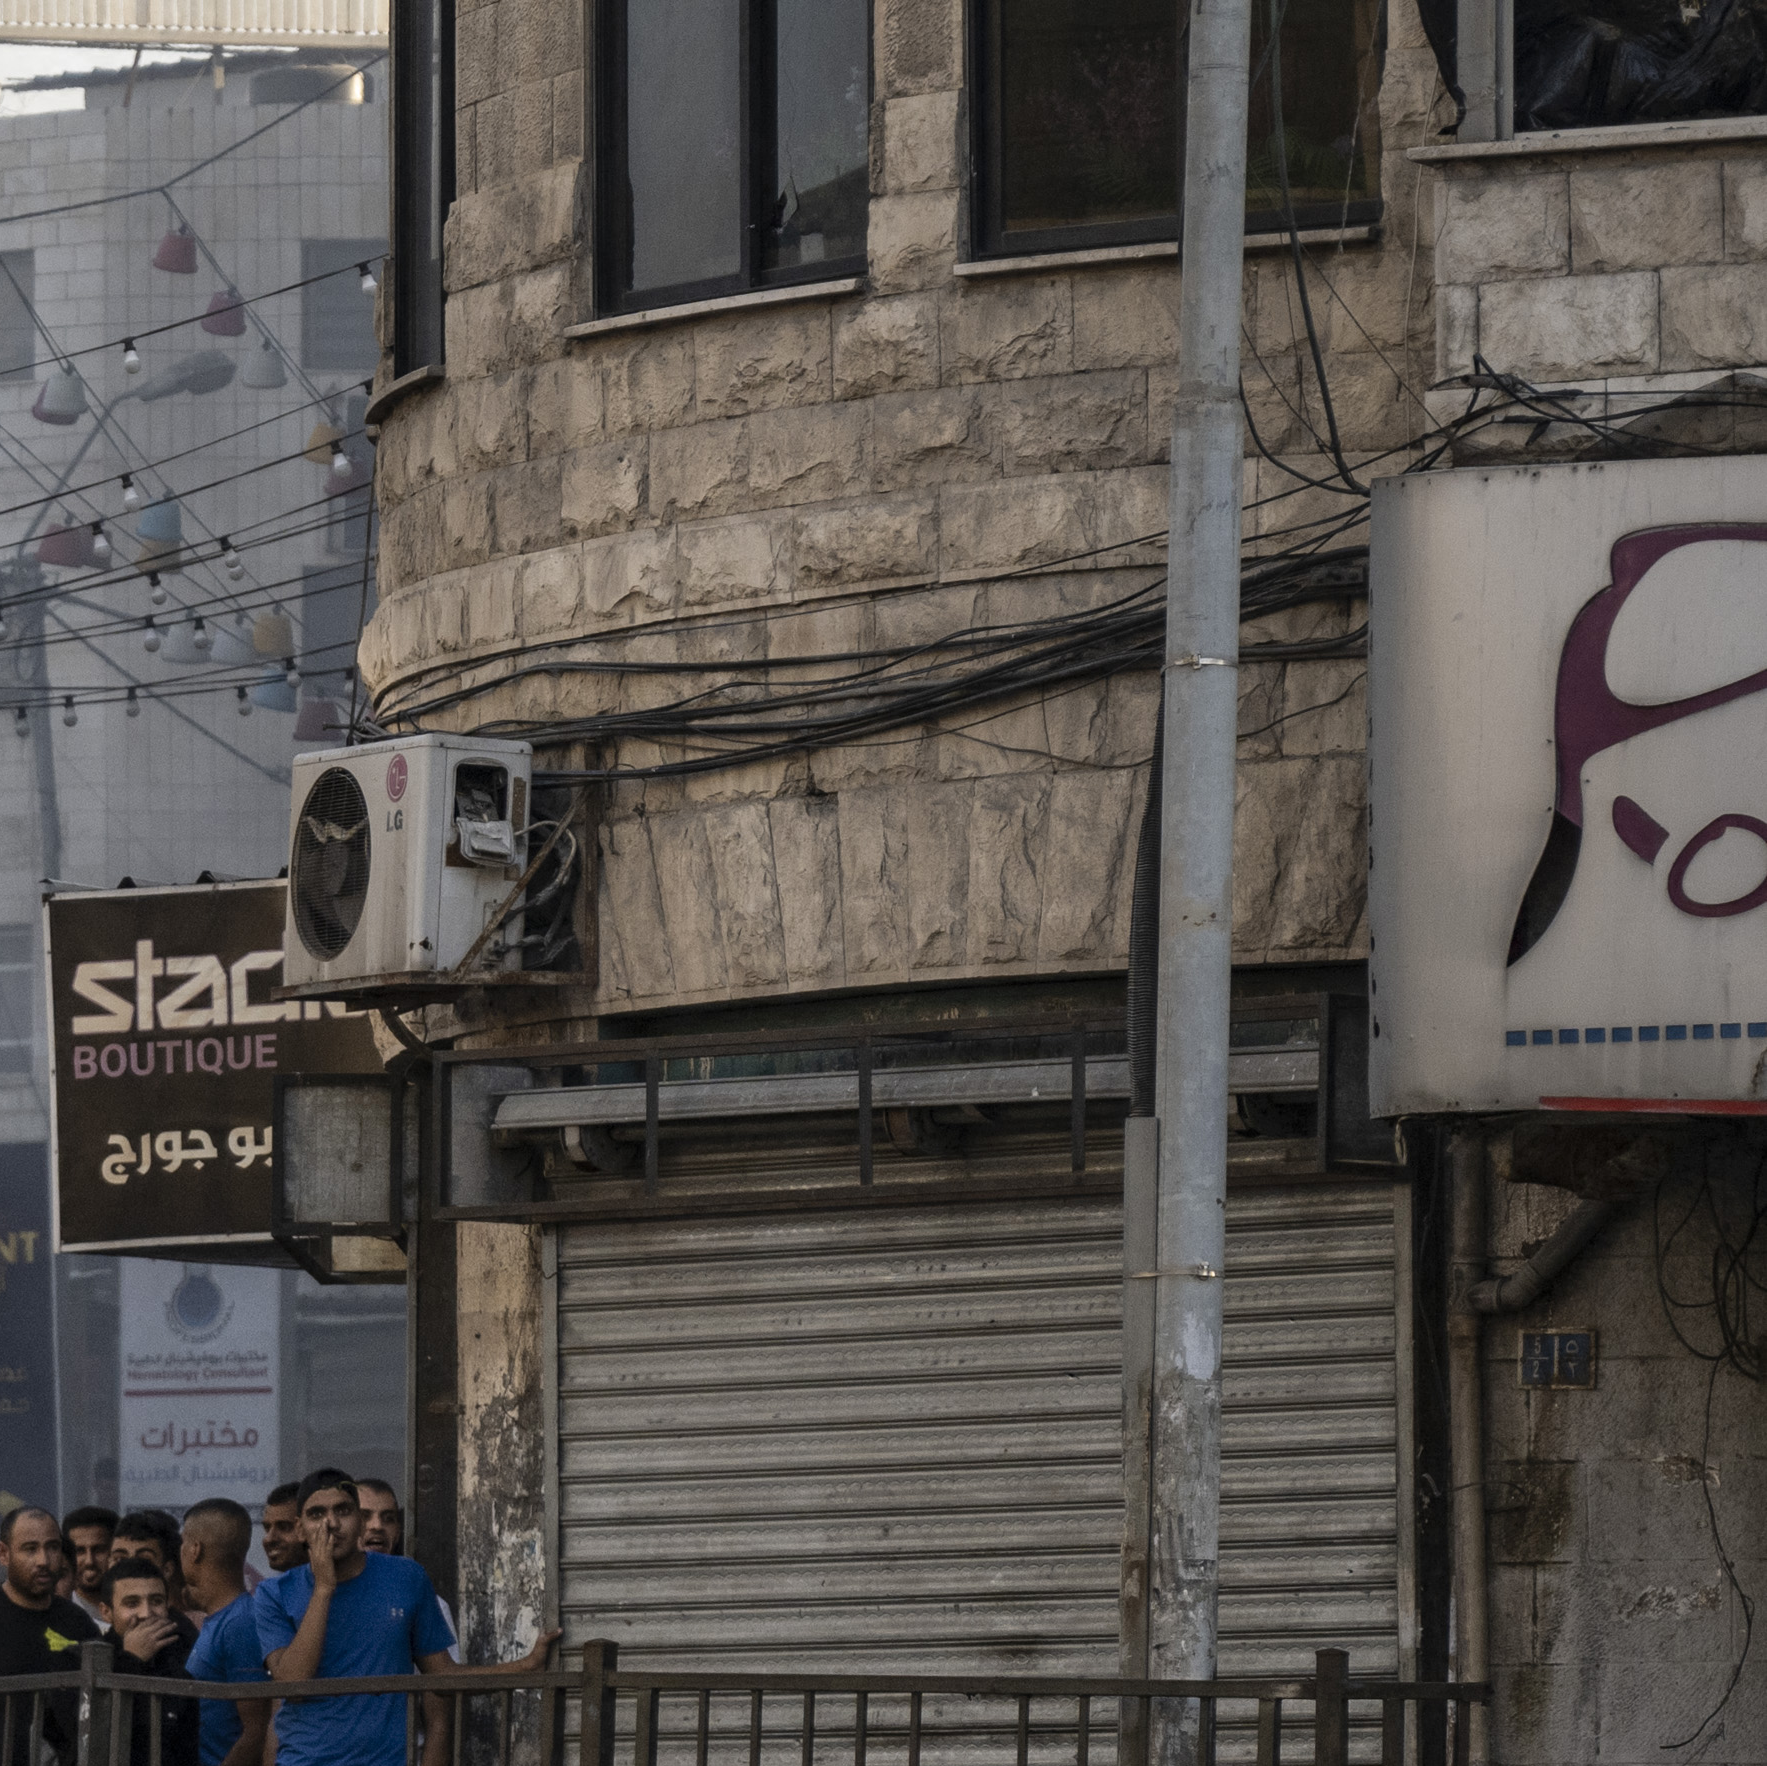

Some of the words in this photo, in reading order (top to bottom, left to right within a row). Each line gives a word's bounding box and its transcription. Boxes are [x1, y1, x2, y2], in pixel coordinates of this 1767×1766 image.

[386, 810, 405, 833] LG
[73, 1034, 278, 1080] BOUTIQUE
[100, 1128, 219, 1186] جورج
[1534, 1336, 1542, 1355] 5
[1532, 1360, 1540, 1378] 2
[140, 1420, 259, 1456] مختبرات
